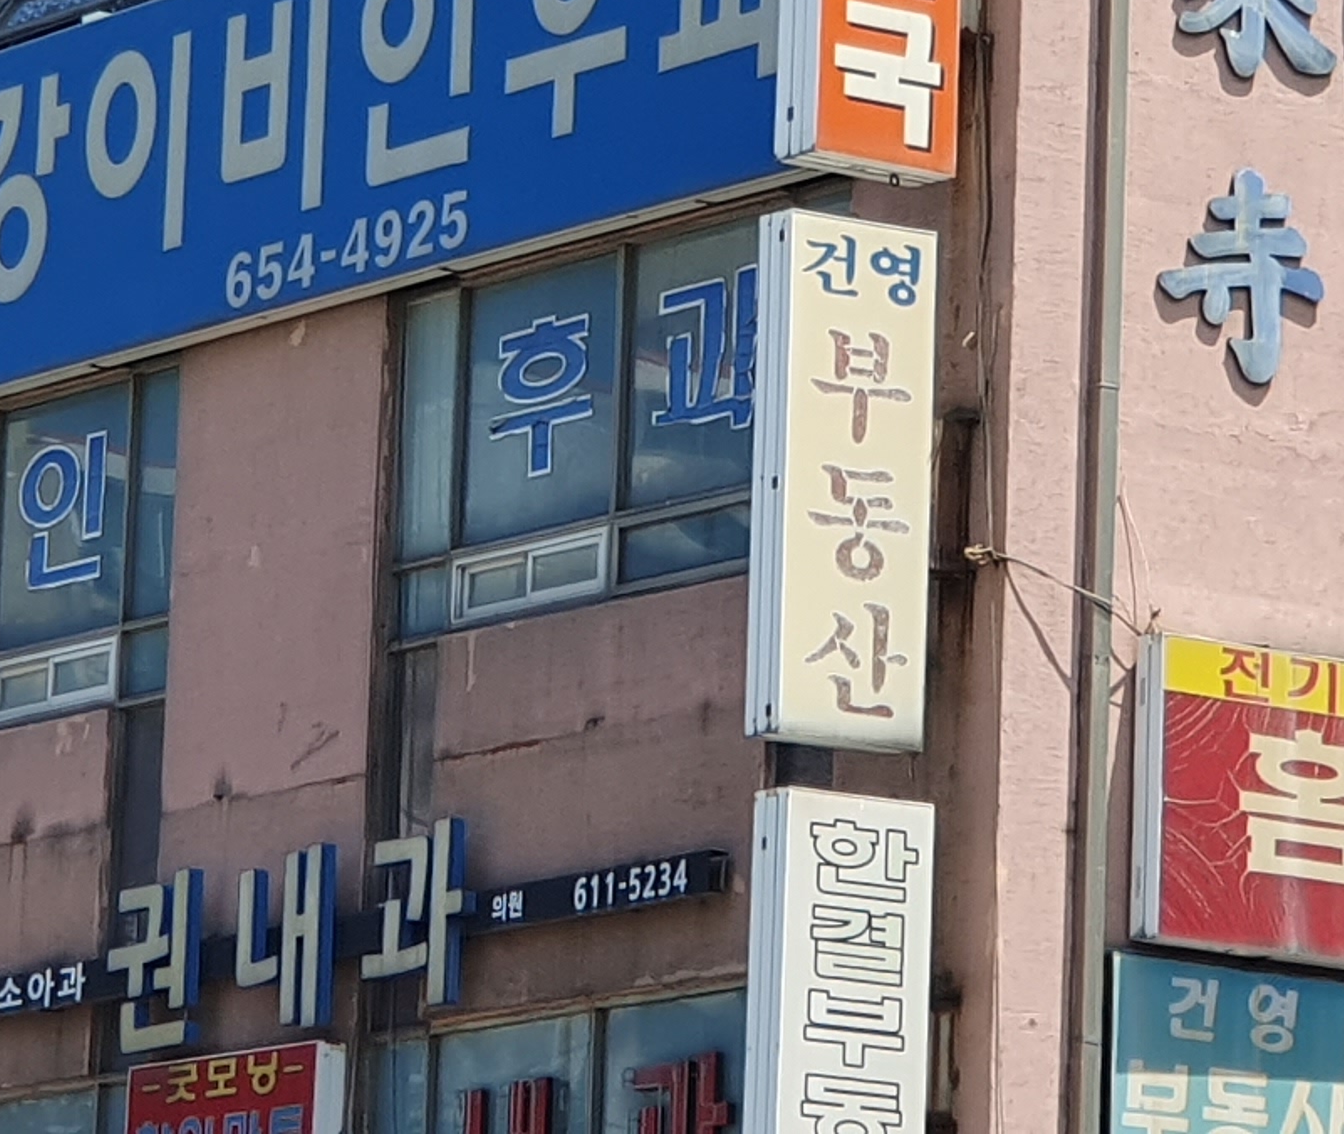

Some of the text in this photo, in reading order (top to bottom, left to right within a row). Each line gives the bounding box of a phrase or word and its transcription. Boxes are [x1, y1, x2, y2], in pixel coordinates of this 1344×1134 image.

[224, 188, 470, 310] 654-4925
[802, 234, 923, 308] 건영
[804, 328, 913, 720] 부동산
[1218, 646, 1341, 714] 전기
[106, 816, 689, 1055] 권내과 의원 611-5234
[1167, 976, 1300, 1055] 건영
